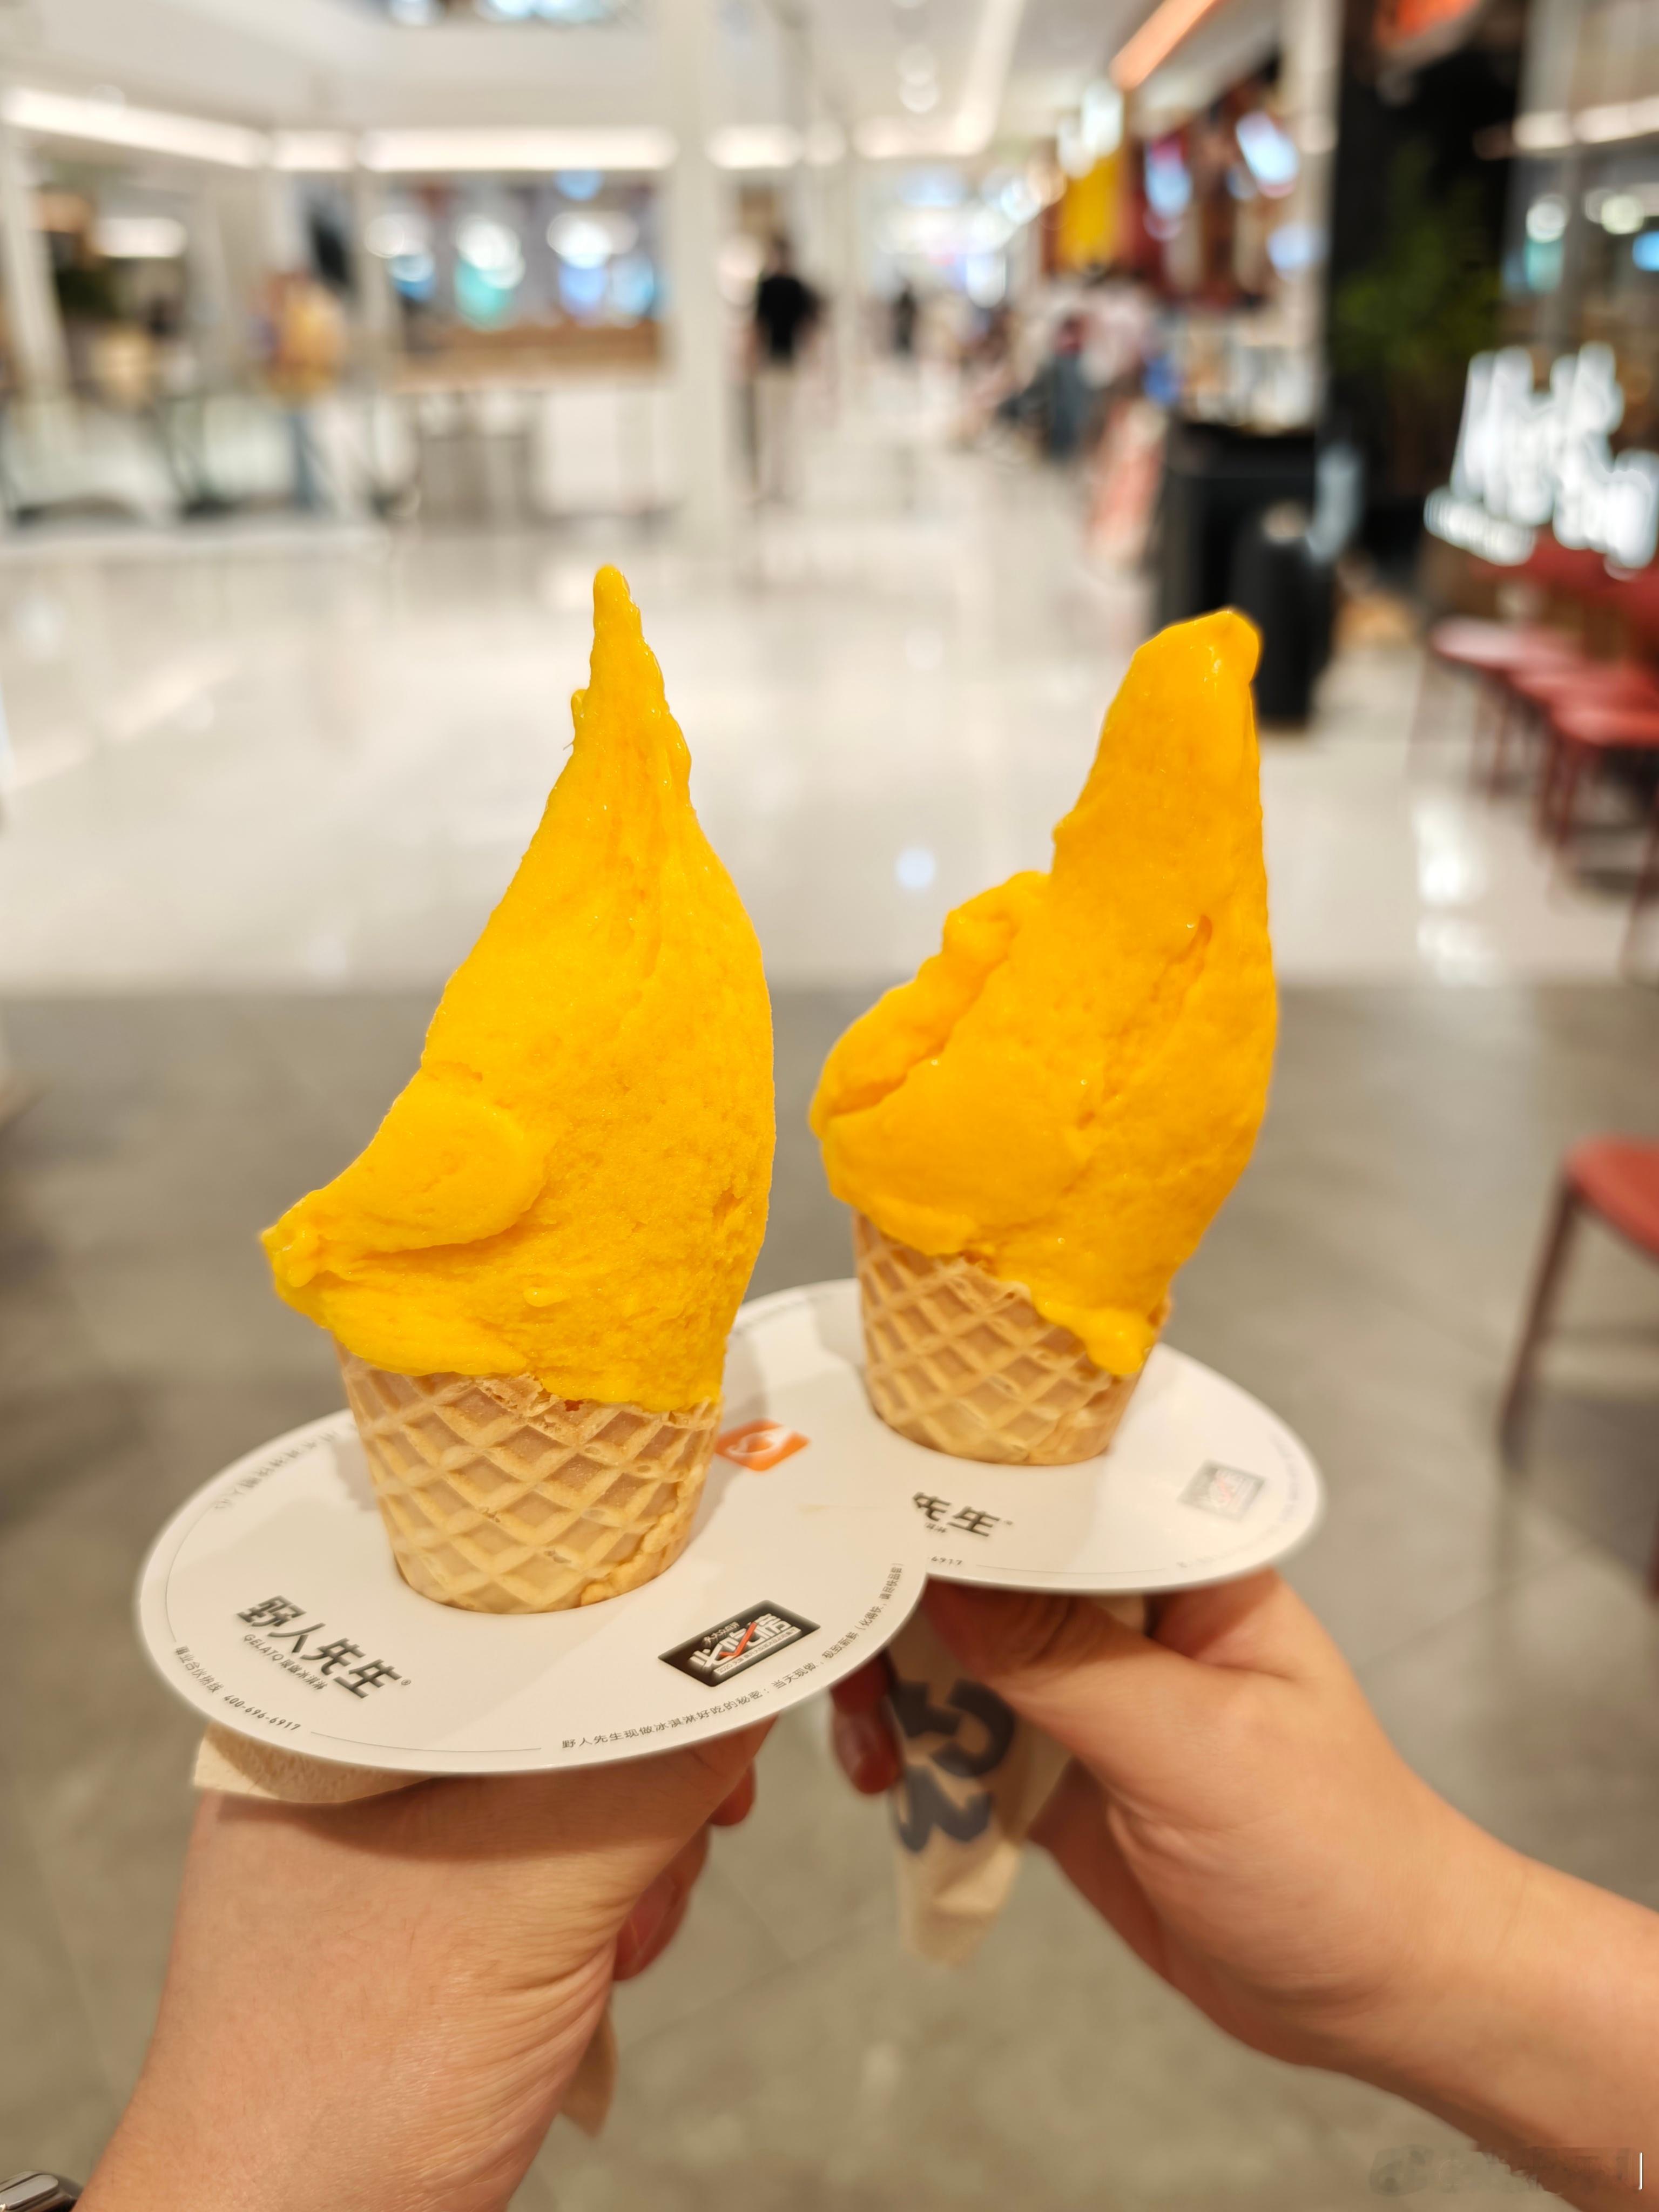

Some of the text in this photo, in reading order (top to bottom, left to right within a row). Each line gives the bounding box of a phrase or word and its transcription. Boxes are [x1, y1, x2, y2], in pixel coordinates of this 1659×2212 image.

[237, 1595, 402, 1698] 野人先生
[224, 1695, 301, 1731] 400-696-6917
